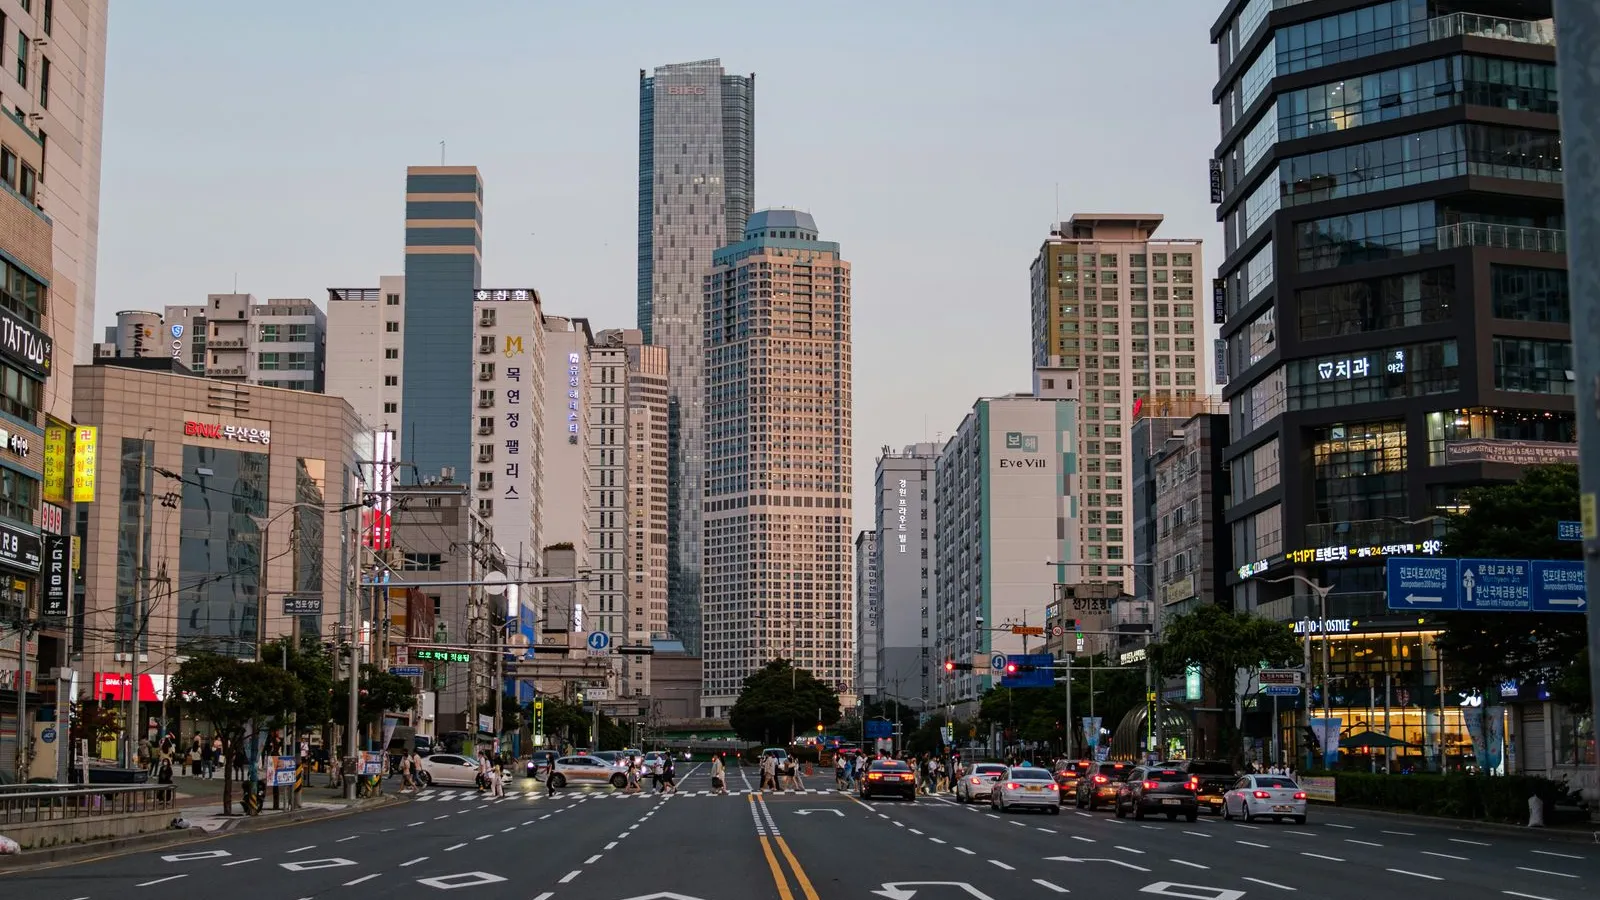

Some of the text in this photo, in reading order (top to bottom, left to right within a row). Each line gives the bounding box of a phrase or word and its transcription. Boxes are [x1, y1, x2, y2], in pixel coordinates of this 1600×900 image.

[668, 86, 705, 95] BIFC
[2, 317, 44, 365] TATTOO
[1336, 358, 1370, 379] 치과
[184, 421, 271, 445] BNK 부산은행
[1000, 459, 1046, 468] Eve Vill
[1315, 545, 1347, 562] 트렌드핏
[1478, 565, 1524, 576] 문현교차로
[1476, 585, 1529, 599] 부산국제금융센터
